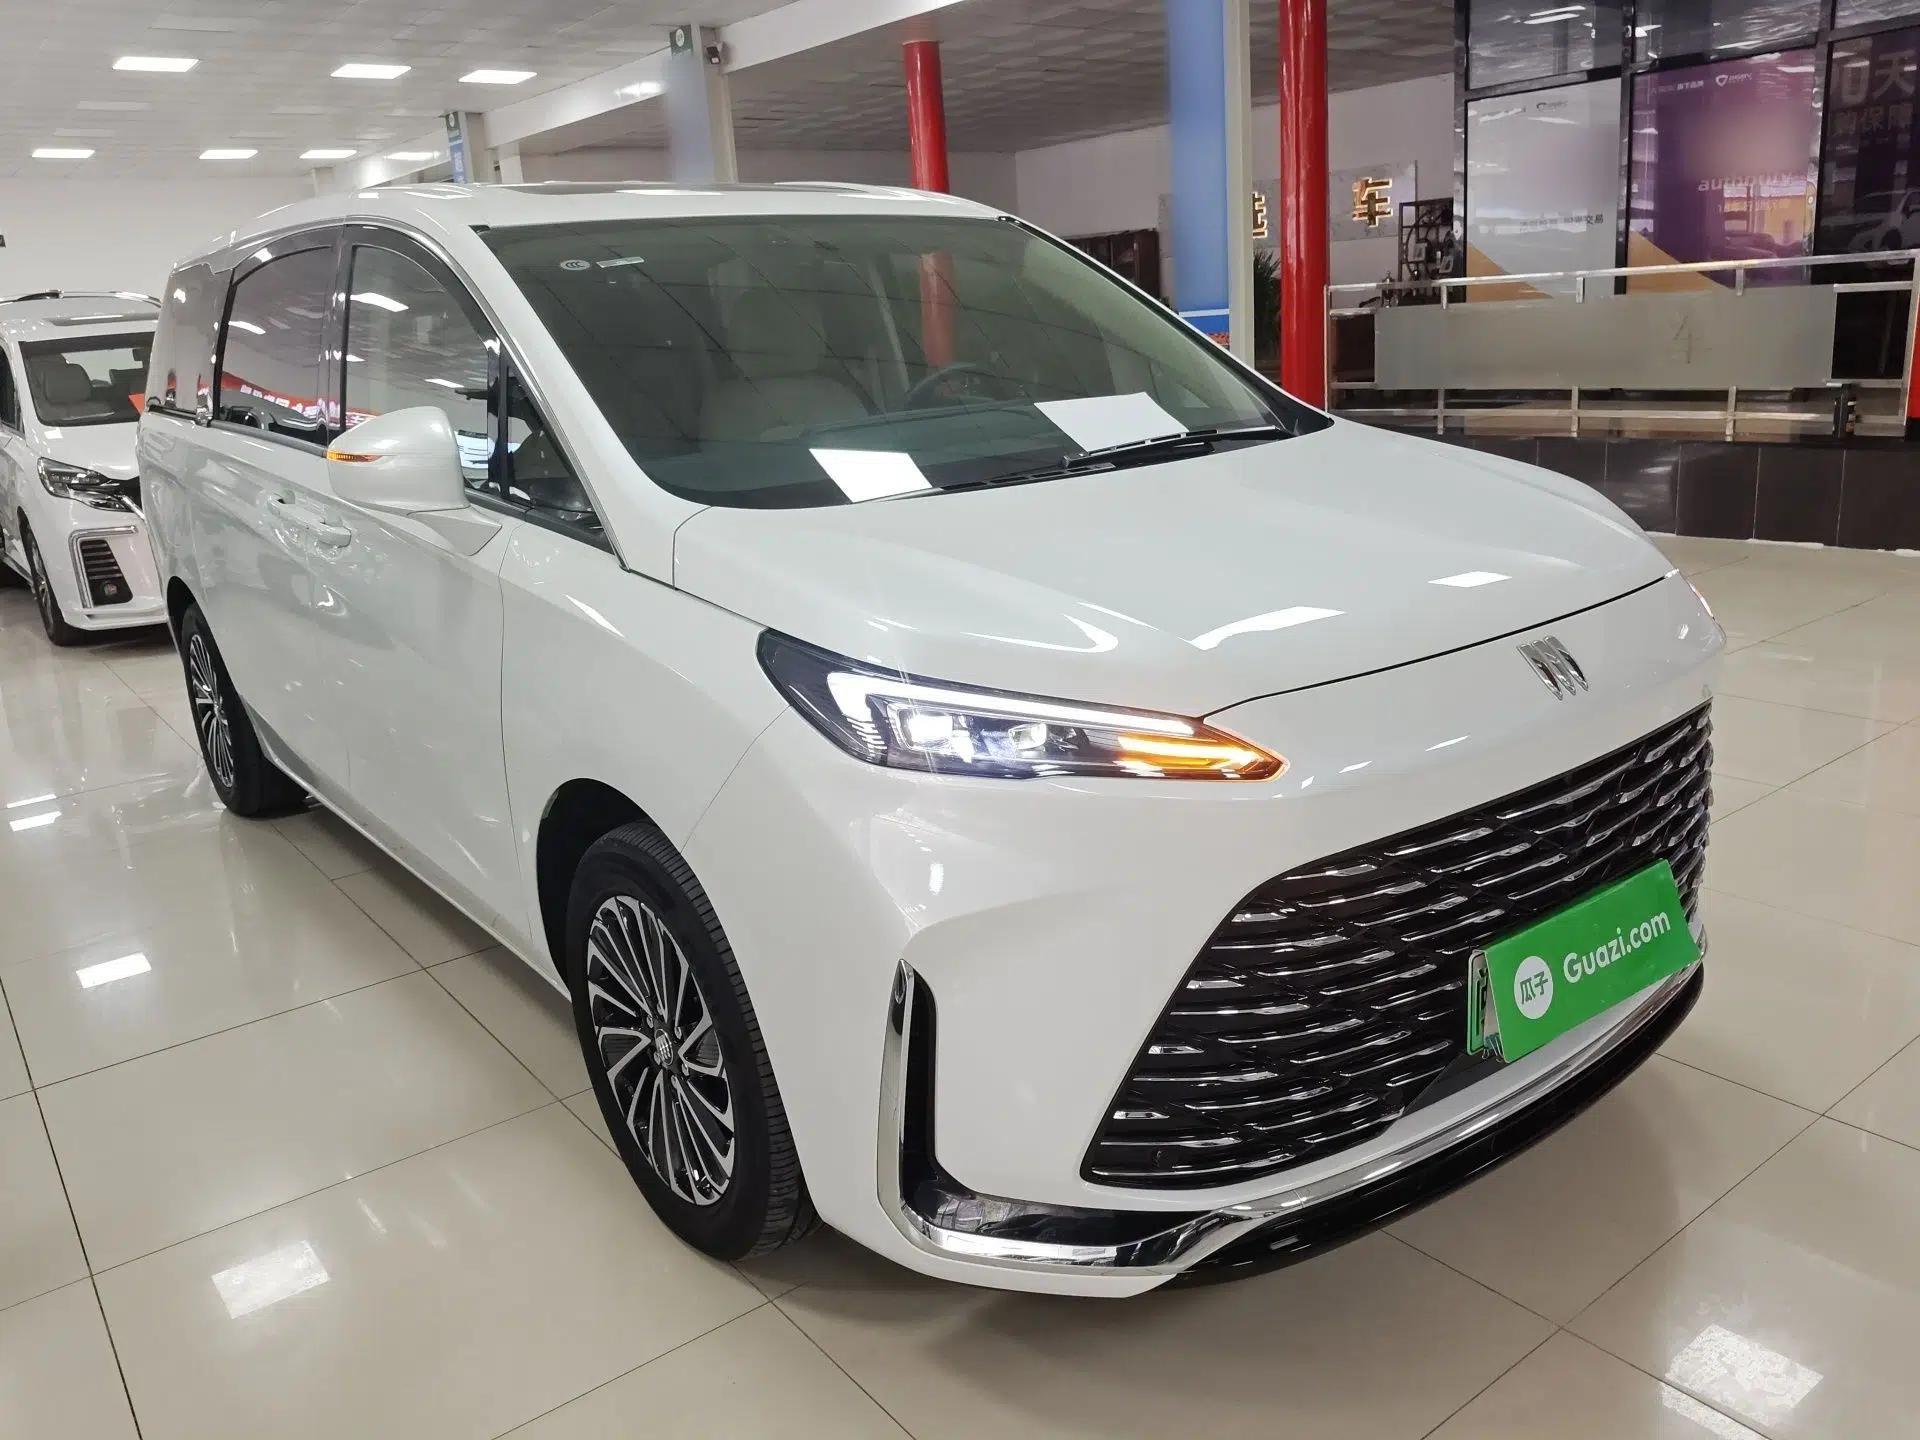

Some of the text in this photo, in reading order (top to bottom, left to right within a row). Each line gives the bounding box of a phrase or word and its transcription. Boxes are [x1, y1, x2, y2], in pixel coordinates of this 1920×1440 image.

[1352, 177, 1393, 228] 车
[1563, 911, 1671, 984] Guazi.com
[1519, 970, 1549, 1005] 瓜子
